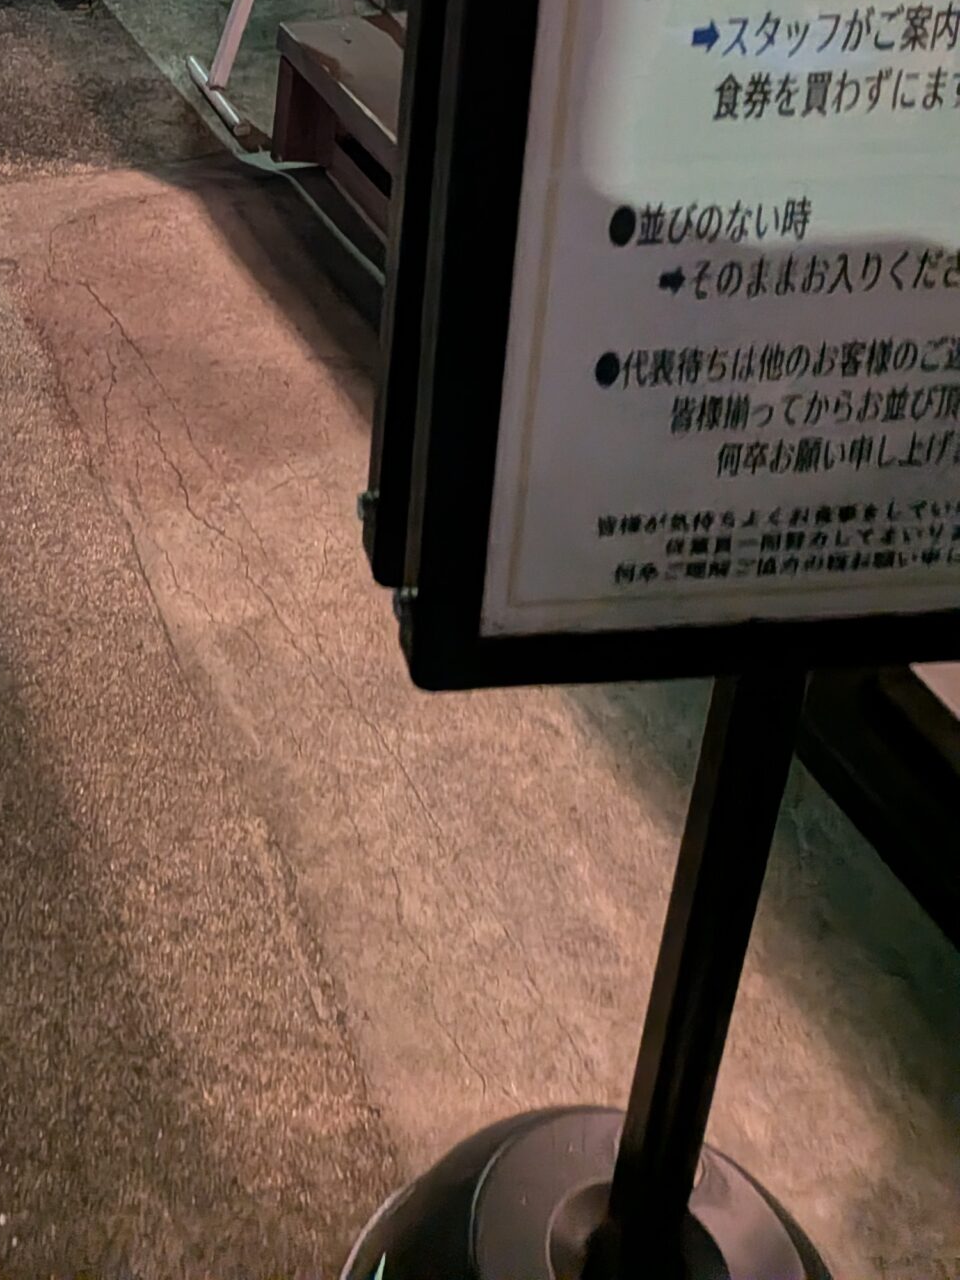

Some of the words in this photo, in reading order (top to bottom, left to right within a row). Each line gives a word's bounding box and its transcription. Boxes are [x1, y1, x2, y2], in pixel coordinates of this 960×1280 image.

[721, 2, 960, 57] スタッフがご案内
[636, 196, 813, 246] 並びのない時
[716, 430, 960, 477] 何卒お願い申し上げ
